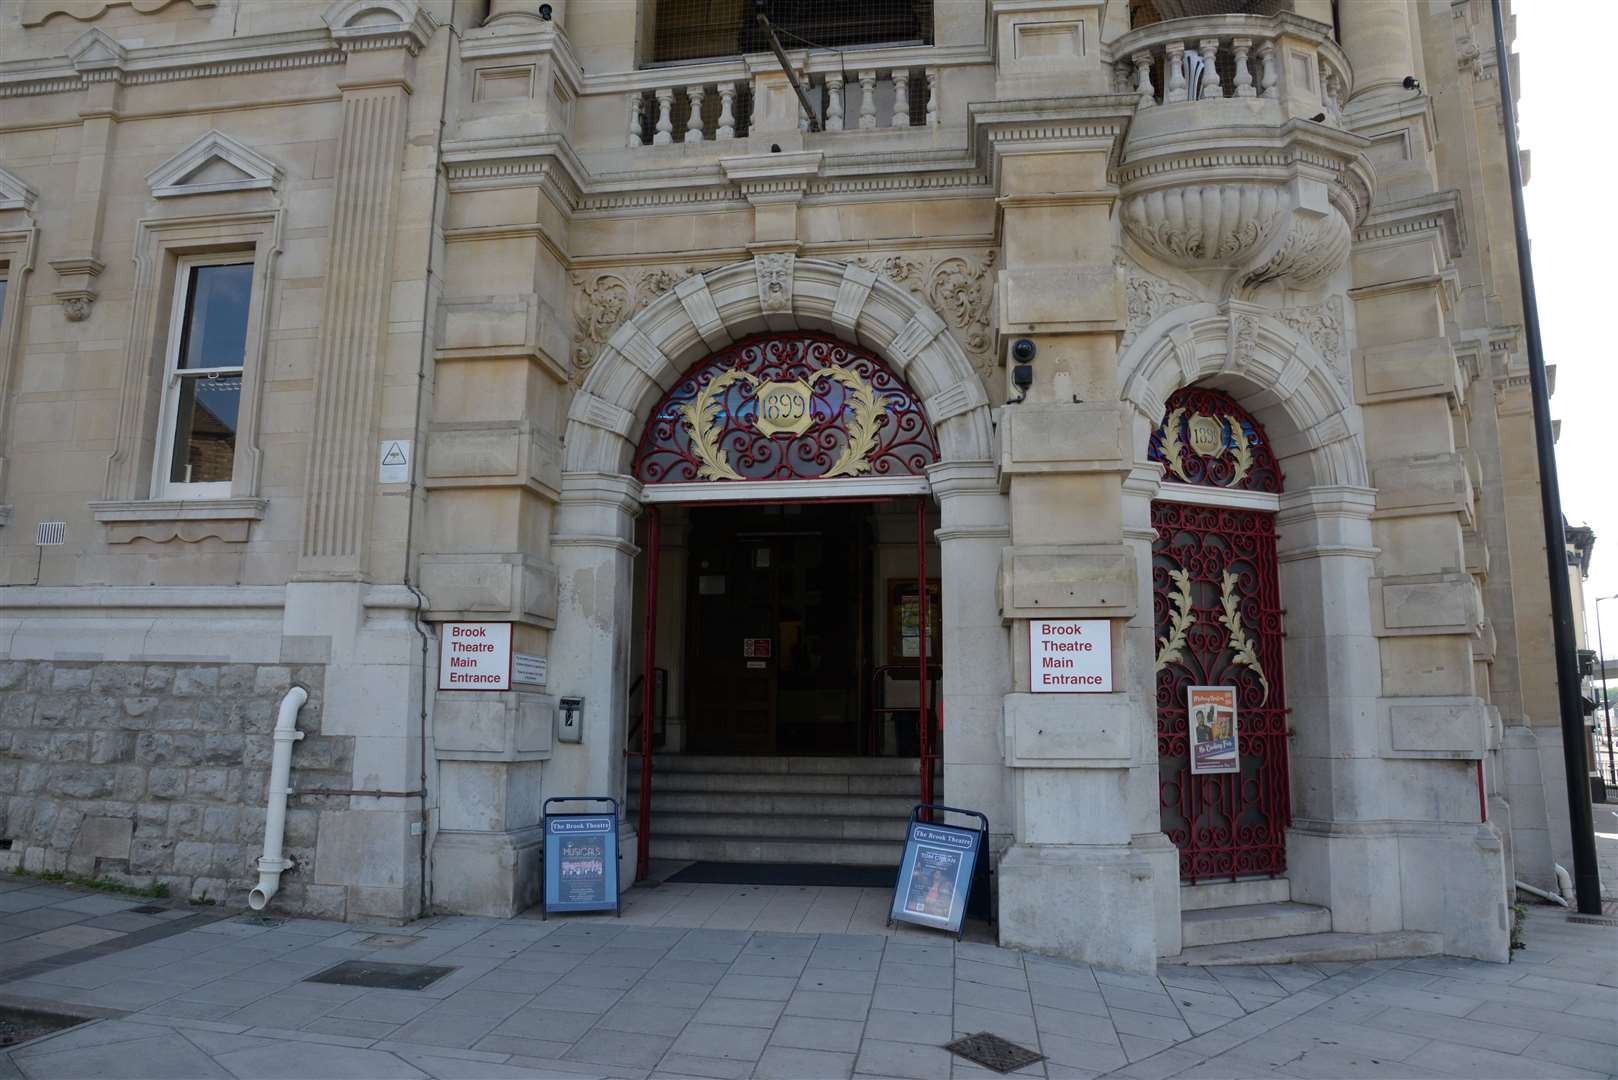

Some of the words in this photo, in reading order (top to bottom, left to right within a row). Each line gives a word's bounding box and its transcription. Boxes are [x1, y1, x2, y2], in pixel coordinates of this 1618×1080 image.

[763, 394, 805, 420] 1899
[452, 626, 486, 637] Brook
[1042, 624, 1082, 635] Brook
[452, 642, 495, 653] Theatre
[1041, 641, 1092, 651] Theatre
[450, 657, 477, 668] Main
[1042, 657, 1074, 668] Main
[450, 672, 501, 683] Entrance
[1043, 674, 1103, 685] Entrance
[928, 833, 946, 841] Brook
[948, 835, 971, 845] Theatre
